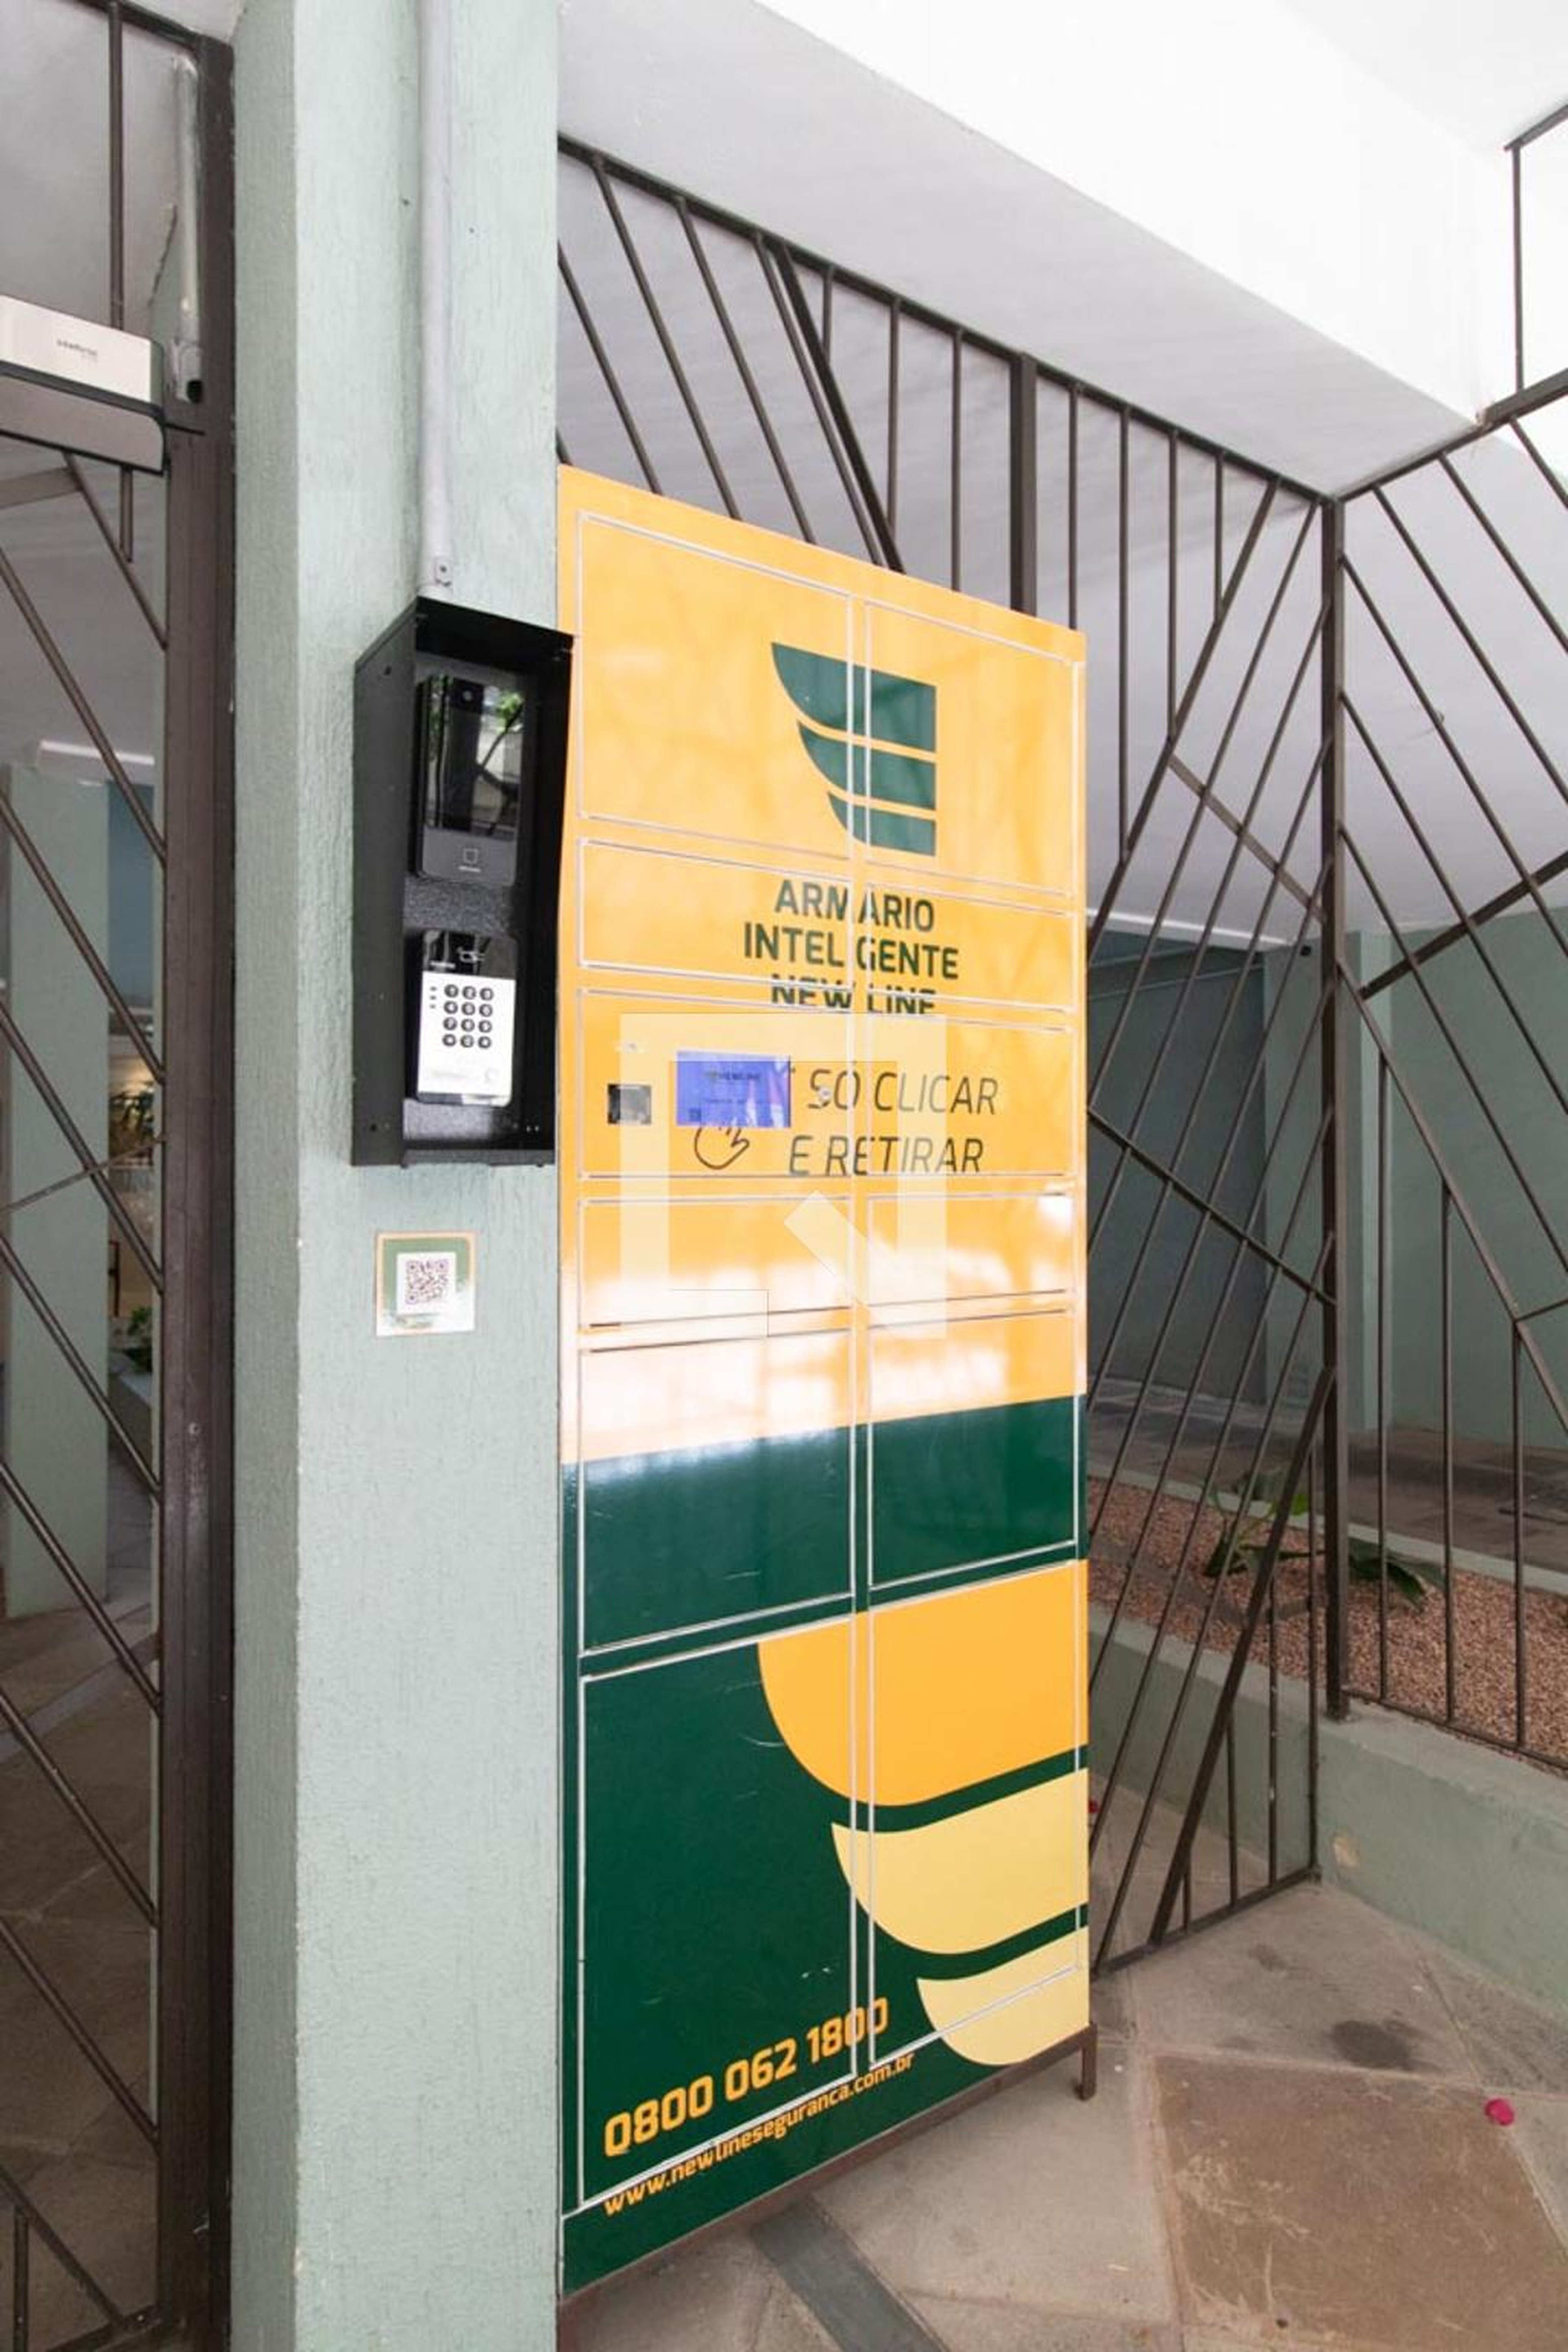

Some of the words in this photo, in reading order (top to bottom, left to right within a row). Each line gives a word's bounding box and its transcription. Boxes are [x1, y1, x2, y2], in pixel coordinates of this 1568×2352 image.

[744, 922, 959, 980] INTELGENTE
[771, 973, 856, 1009] NEW
[874, 1072, 998, 1115] CLICAR
[789, 1135, 814, 1176] E
[825, 1135, 984, 1176] RETIRAR
[604, 2075, 714, 2156] 0800
[724, 2038, 797, 2101] 062
[806, 1997, 889, 2064] 1800
[602, 2054, 915, 2216] www.newlineseguranca.com.br
